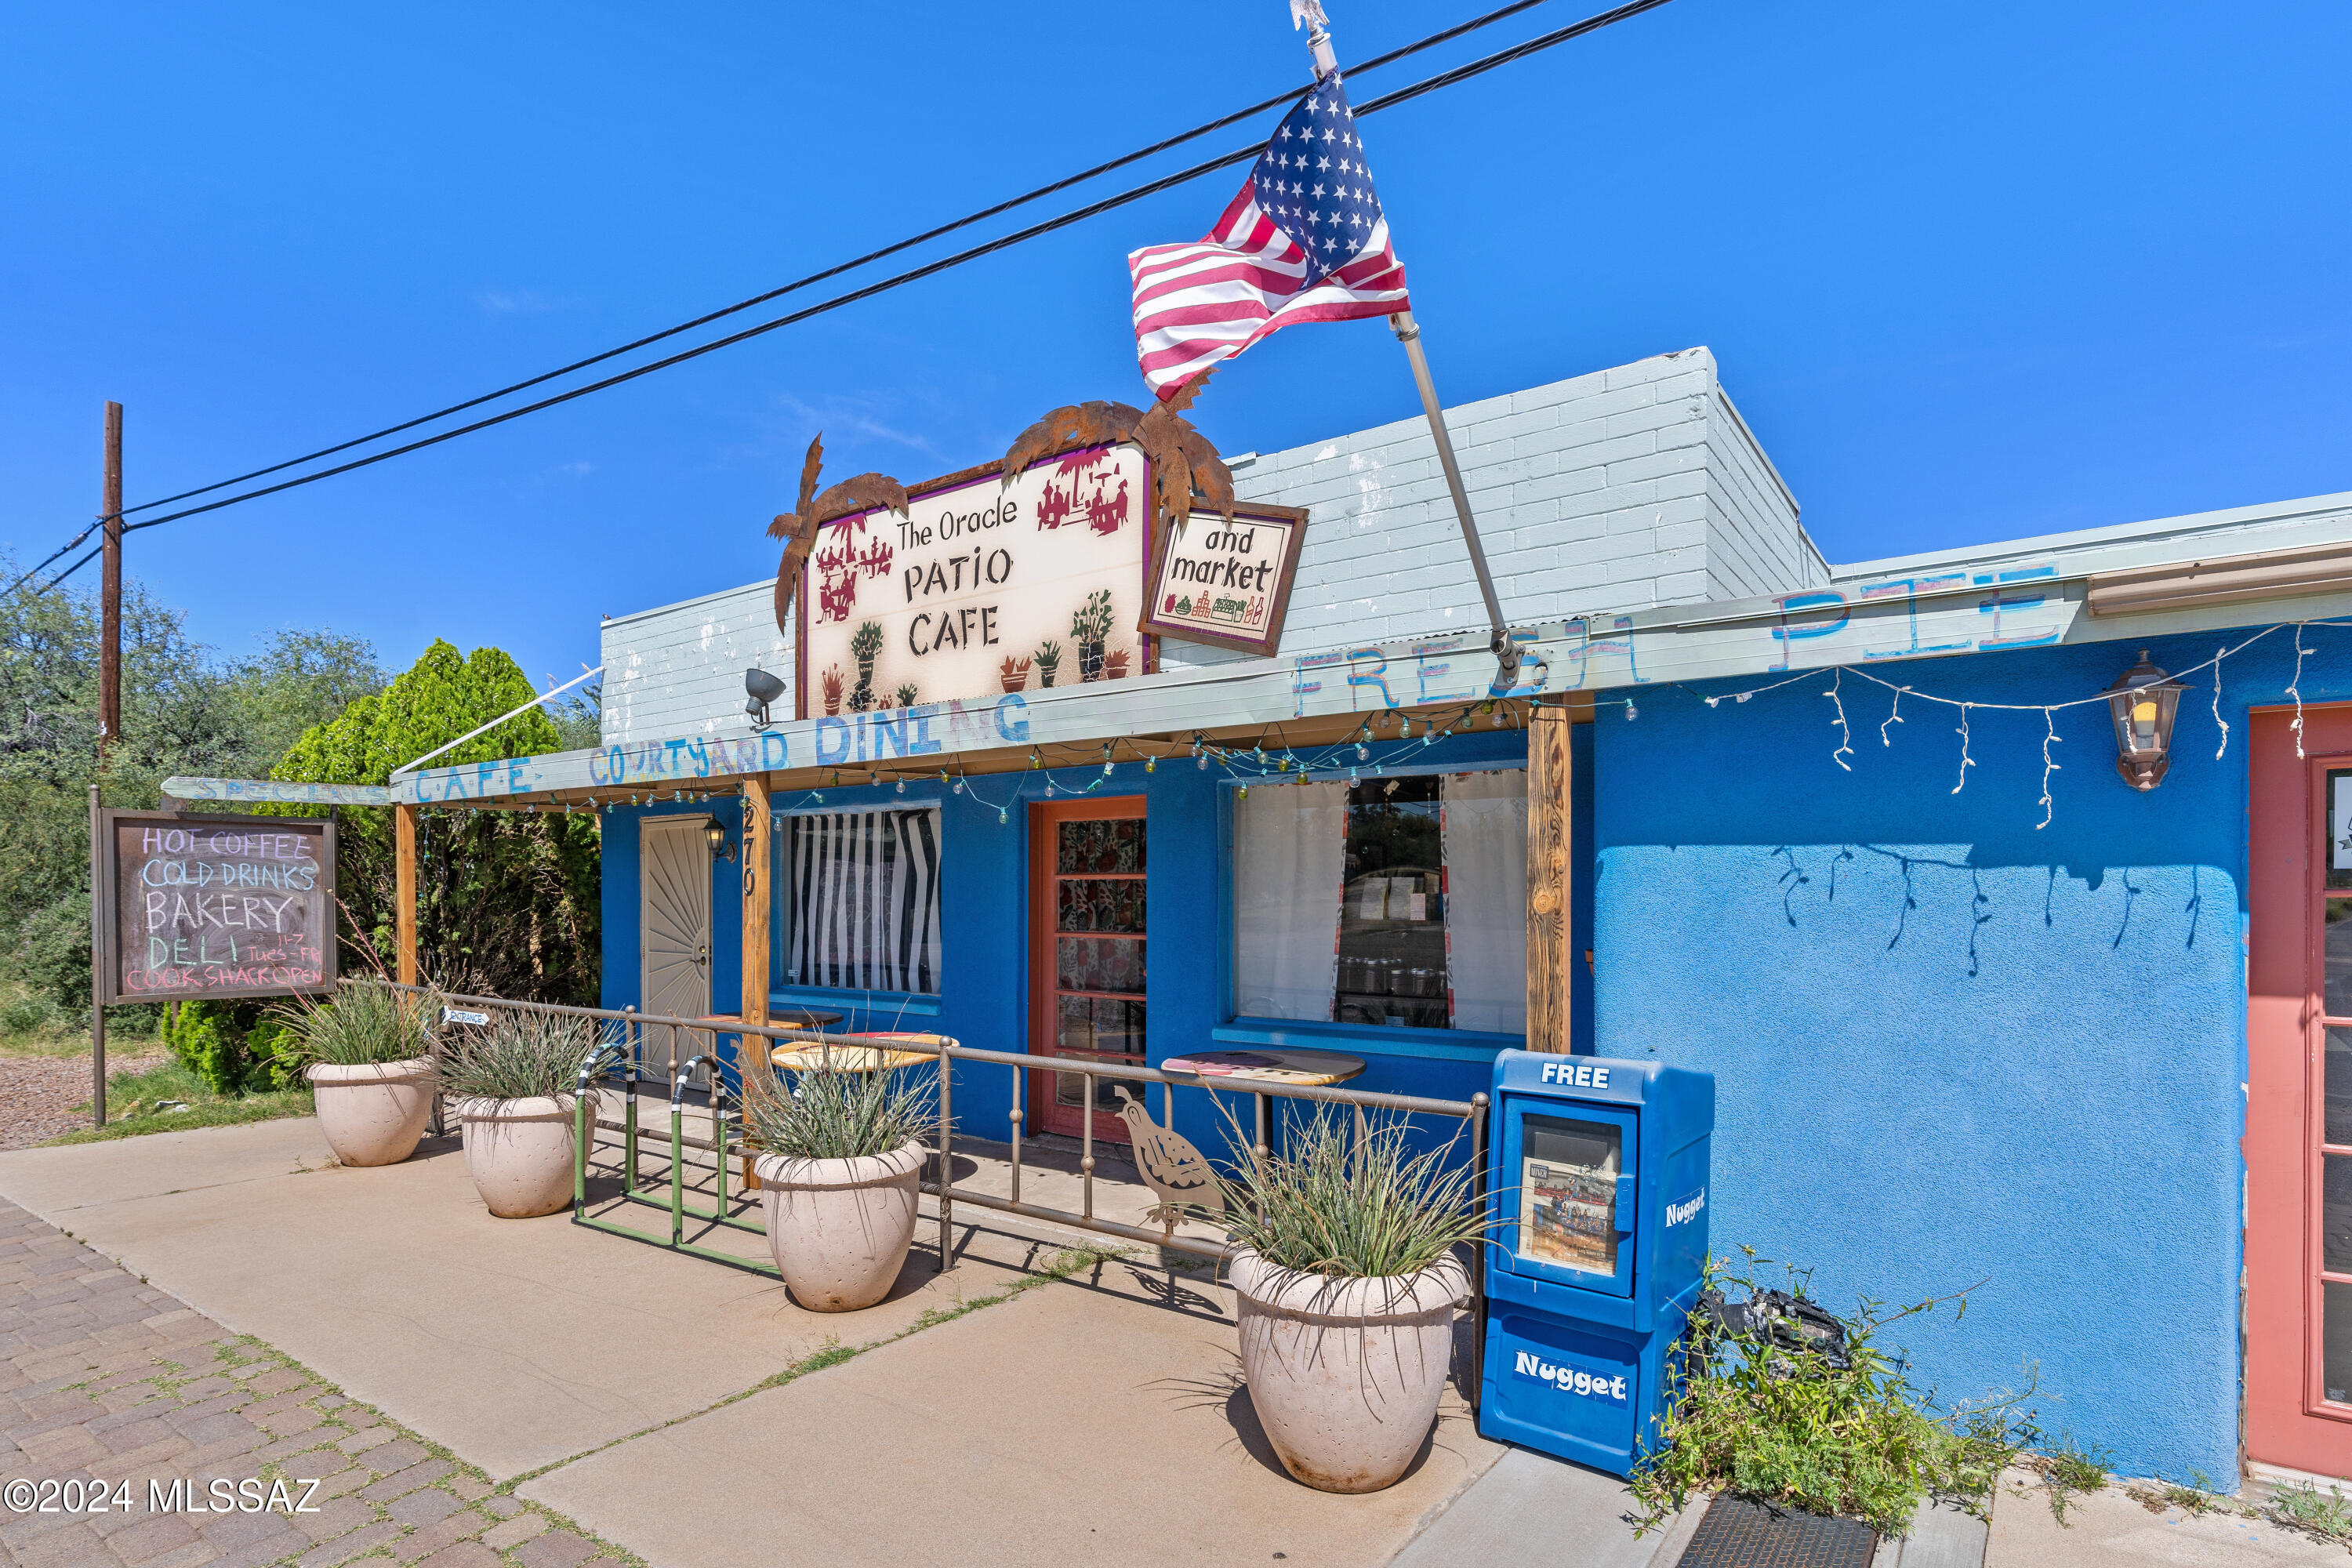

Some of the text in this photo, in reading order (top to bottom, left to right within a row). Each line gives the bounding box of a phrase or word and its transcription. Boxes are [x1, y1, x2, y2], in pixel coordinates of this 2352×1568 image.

[897, 495, 1018, 551] The Oracle
[1204, 527, 1254, 554] and
[1172, 556, 1273, 593] market
[909, 606, 1000, 657] CAFE
[589, 730, 789, 786] COURTYARD
[816, 693, 1030, 767] DINING
[143, 828, 310, 858] HOT COFFEE
[743, 806, 755, 897] 270
[142, 859, 315, 891] COLD DRINKS
[145, 891, 294, 933] BAKERY
[148, 935, 238, 970] DELI
[127, 965, 322, 990] COOK SHACK OPEN
[1540, 1062, 1610, 1089] FREE
[1530, 1167, 1548, 1178] MINER
[1665, 1188, 1705, 1228] Nugget
[1513, 1352, 1627, 1402] Nugget
